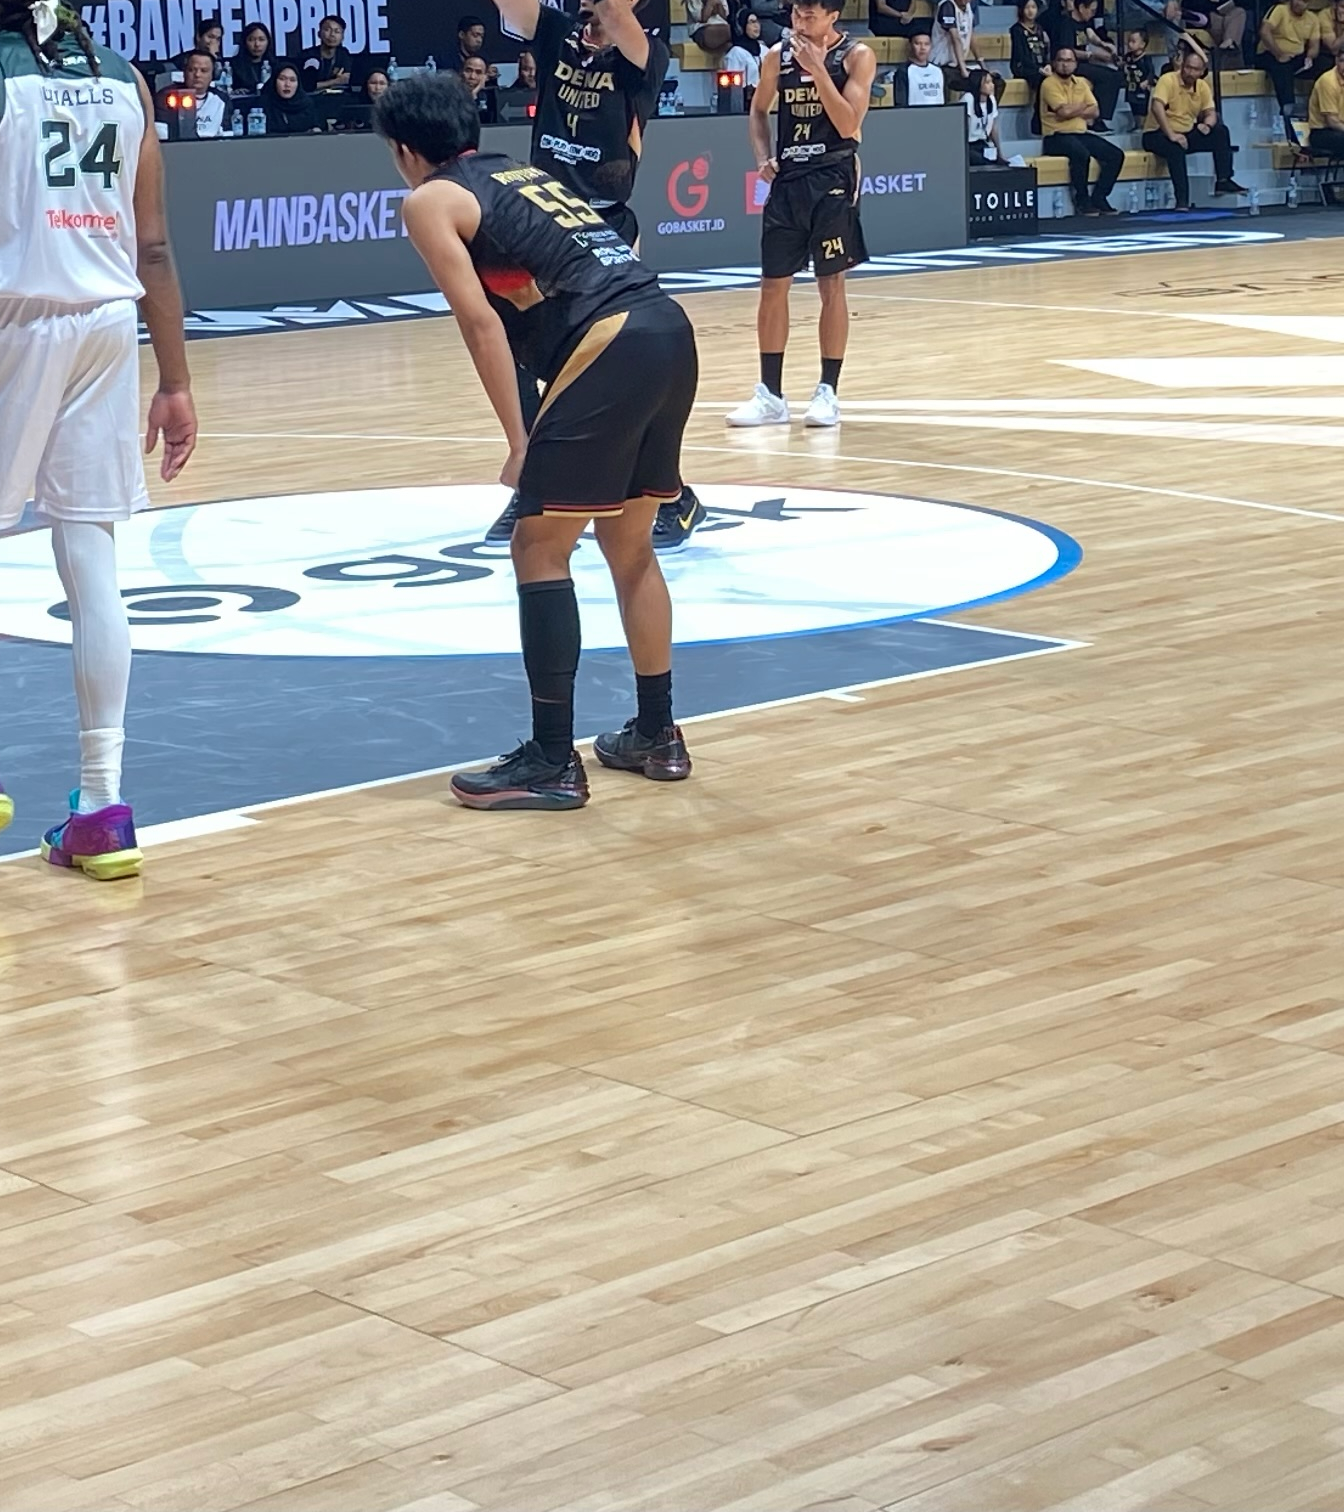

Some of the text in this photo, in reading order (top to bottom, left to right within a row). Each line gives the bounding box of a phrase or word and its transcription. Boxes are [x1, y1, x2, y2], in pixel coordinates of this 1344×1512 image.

[785, 87, 821, 104] DEW
[567, 112, 579, 138] 4
[793, 123, 812, 142] 24
[41, 120, 122, 189] 24
[859, 173, 927, 196] ASKET
[518, 181, 605, 229] 55
[656, 208, 725, 225] GOBASKET.ID
[822, 237, 844, 259] 24
